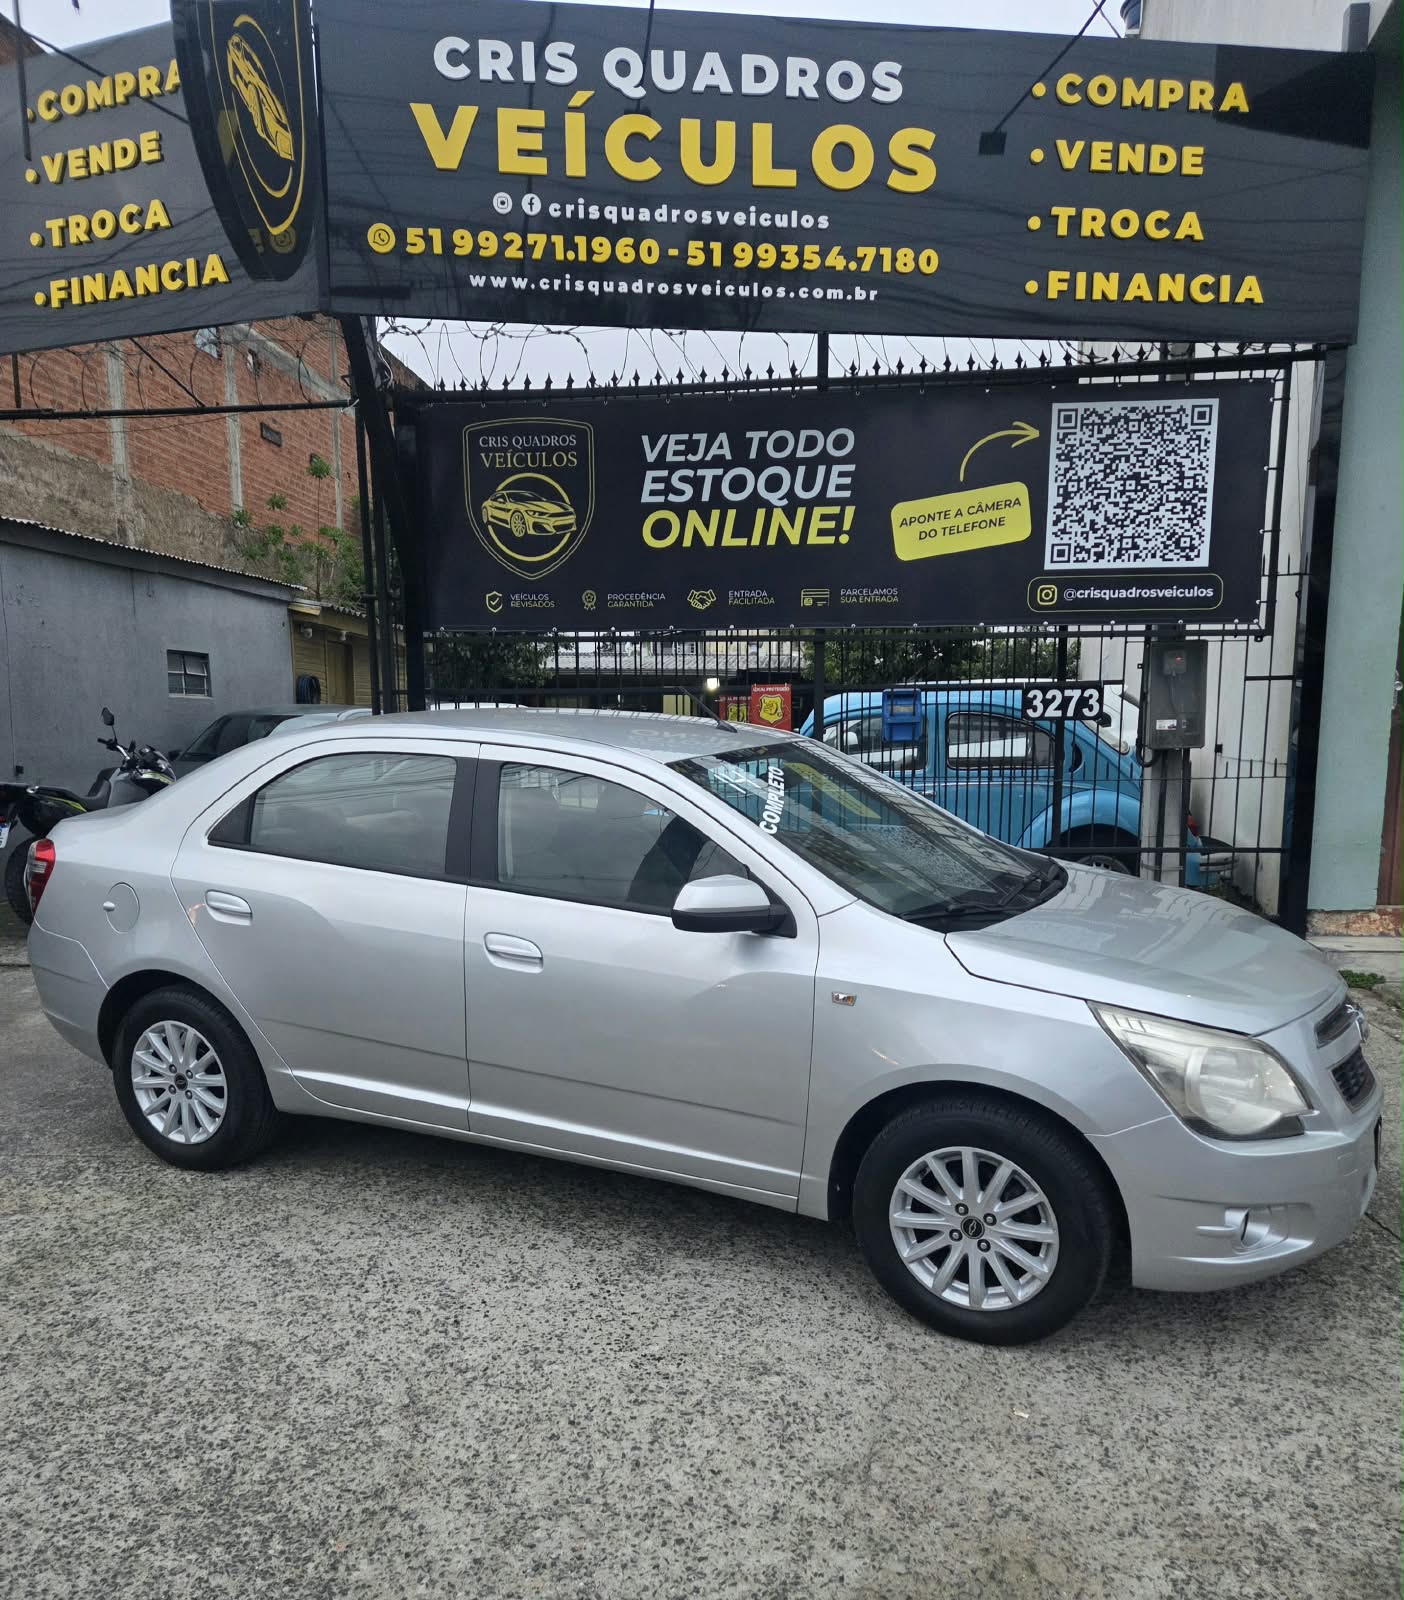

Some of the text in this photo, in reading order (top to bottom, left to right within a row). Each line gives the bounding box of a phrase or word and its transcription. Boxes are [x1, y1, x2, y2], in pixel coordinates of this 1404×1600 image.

[433, 36, 903, 104] CRIS QUADROS
[1056, 73, 1250, 113] COMPRA
[42, 130, 163, 184] VENDE
[410, 90, 938, 193] VEÍCULOS
[1055, 140, 1205, 176] VENDE
[46, 199, 172, 248] TROCA
[548, 198, 831, 230] crisquadrosveiculos
[1050, 206, 1205, 241] TROCA
[406, 227, 444, 256] 51
[452, 229, 660, 265] 99271.1960
[687, 241, 723, 268] 51
[733, 242, 940, 275] 99354.7180
[49, 254, 230, 309] FINANCIA
[469, 270, 879, 301] www.crisquadrosveiculos.com.br
[1047, 270, 1265, 304] FINANCIA
[479, 434, 577, 449] CRIS QUADROS
[641, 427, 856, 463] VEJA TODO
[480, 449, 577, 468] VEÍCULOS
[640, 464, 857, 507] ESTOQUE
[642, 505, 857, 549] ONLINE!
[899, 497, 1022, 528] APONTE A CÂMERA
[918, 516, 1007, 541] DO TELEFONE
[510, 593, 549, 601] VEÍCULOS
[607, 592, 666, 601] PROCEDÊNCIA
[607, 600, 654, 608] GARANTIDA
[728, 590, 768, 598] ENTRADA
[728, 597, 775, 605] FACILITADA
[840, 588, 899, 596] PARCELAMOS
[859, 595, 899, 603] ENTRADA
[1063, 585, 1215, 602] @crisquadrosveiculos
[1026, 688, 1100, 718] 3273
[759, 765, 785, 835] COMPLETO
